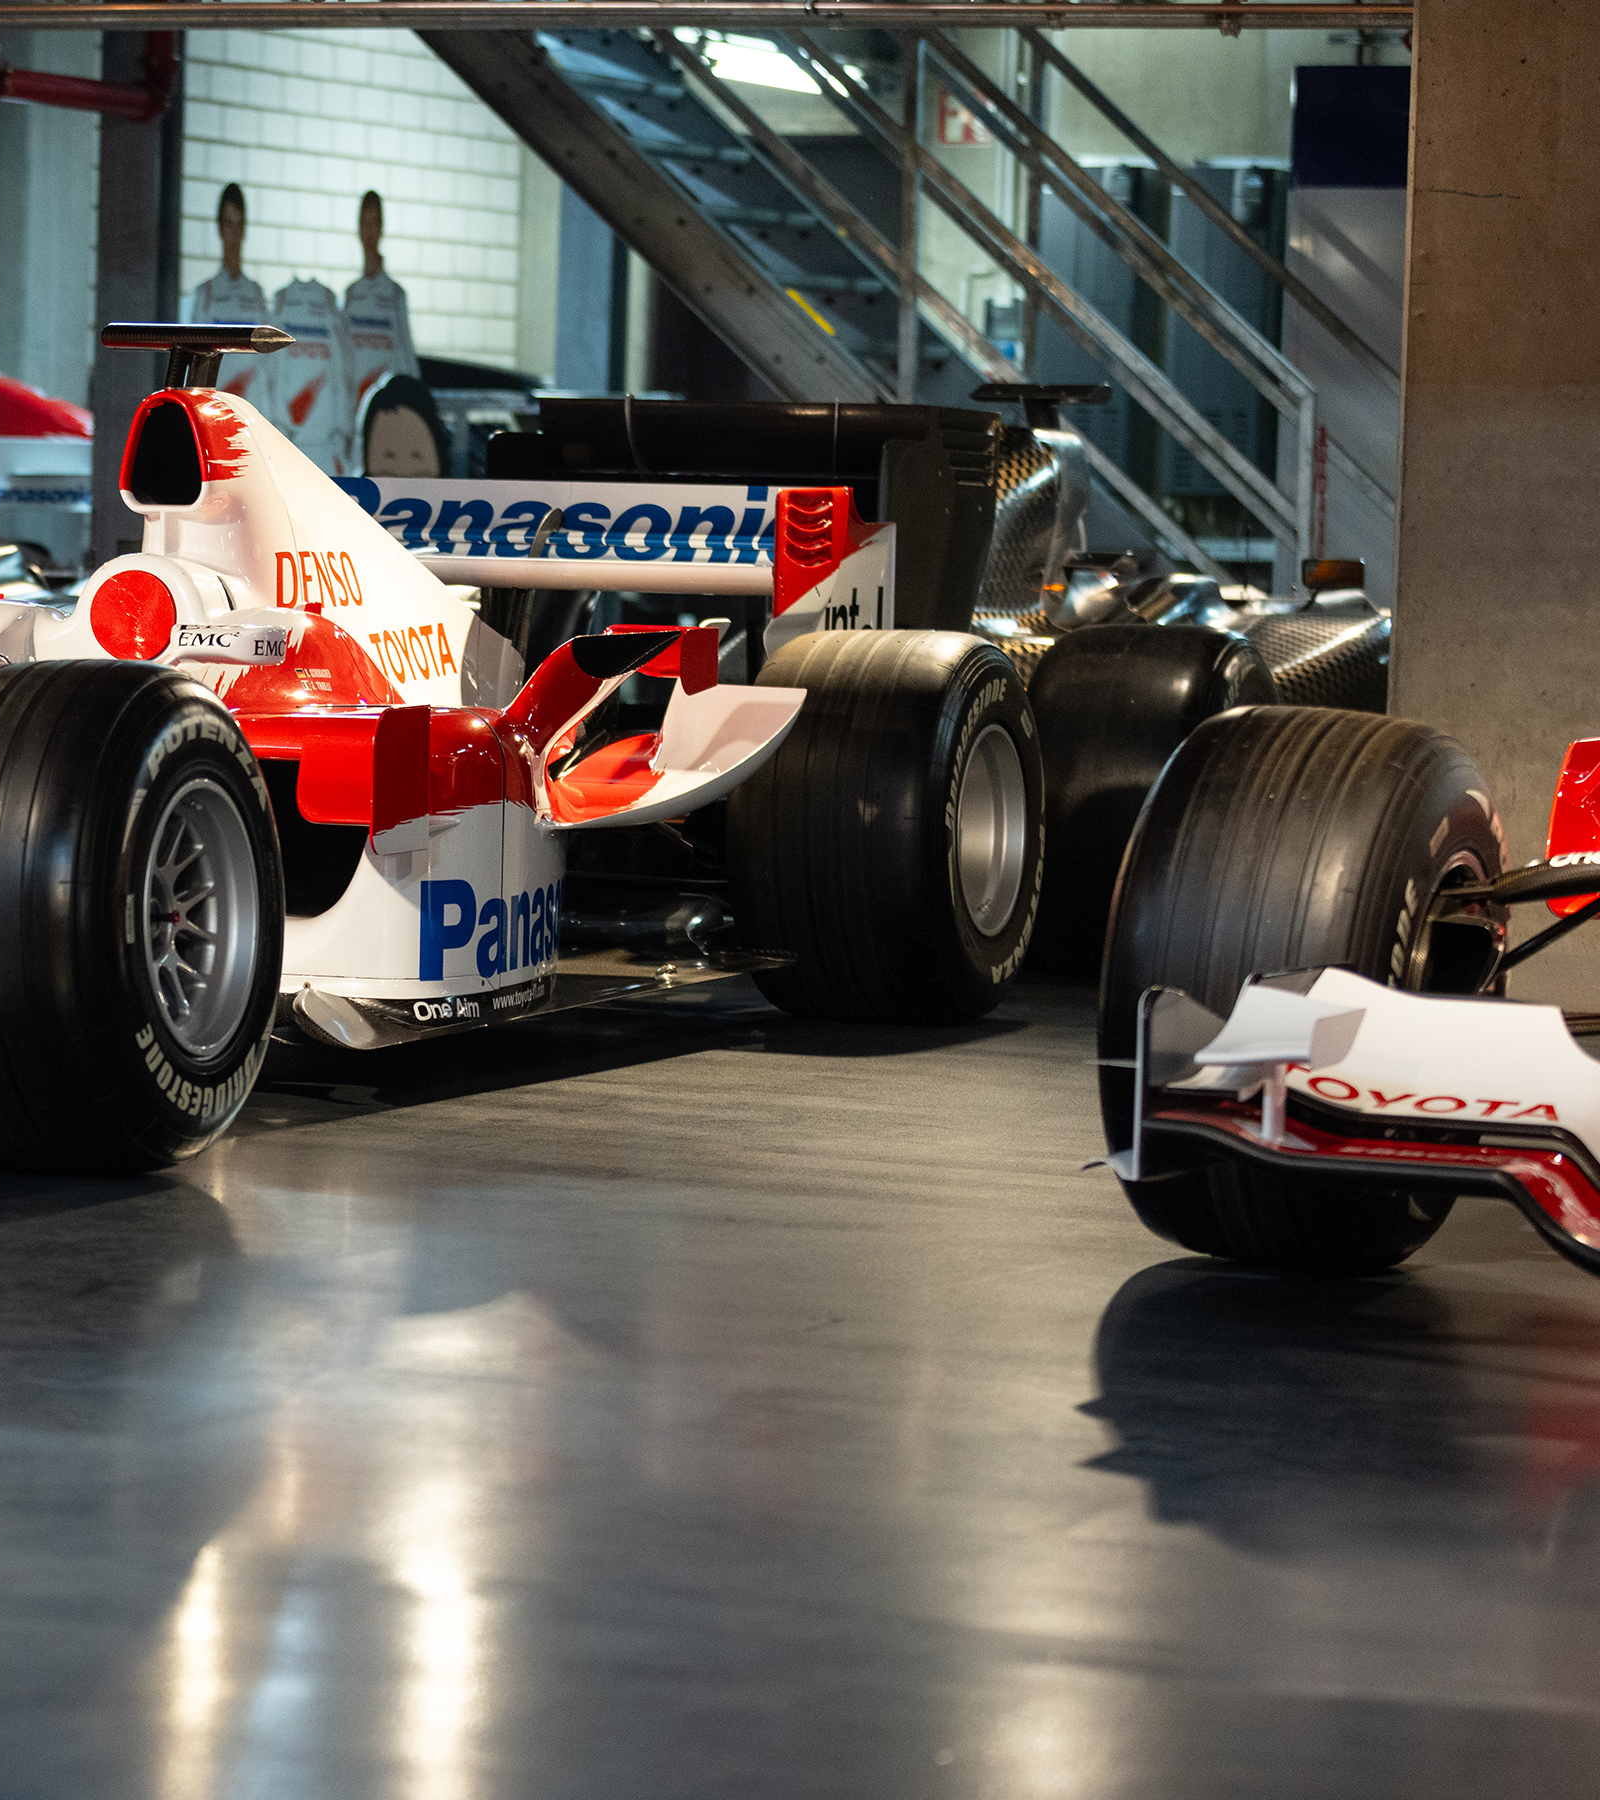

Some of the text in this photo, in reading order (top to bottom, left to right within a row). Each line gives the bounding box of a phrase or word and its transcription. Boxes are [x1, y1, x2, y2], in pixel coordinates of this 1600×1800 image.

[275, 551, 364, 609] DENSO
[824, 586, 884, 630] intl
[368, 623, 458, 684] TOYOTA
[147, 713, 267, 812] POTENZA
[413, 997, 480, 1022] One Aim
